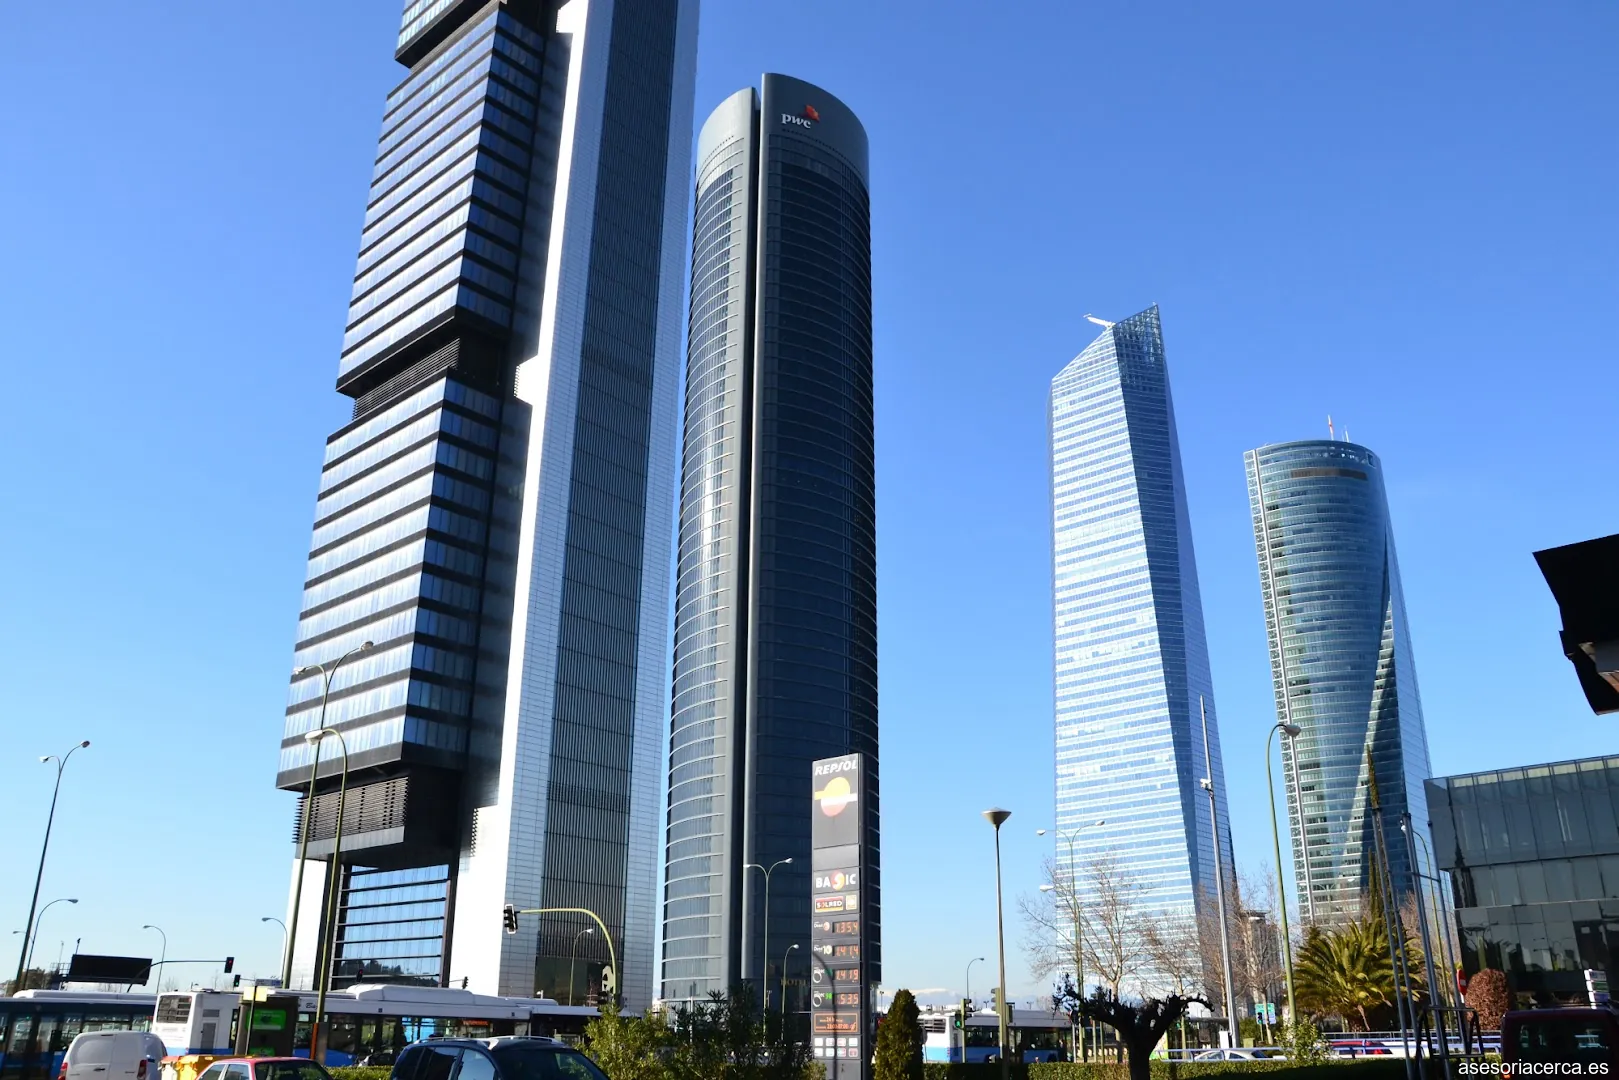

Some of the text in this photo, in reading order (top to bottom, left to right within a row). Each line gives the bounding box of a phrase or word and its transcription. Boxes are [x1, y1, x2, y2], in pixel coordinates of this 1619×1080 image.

[781, 113, 811, 129] pwc
[814, 760, 858, 776] REPSOL
[815, 873, 857, 889] BASIC
